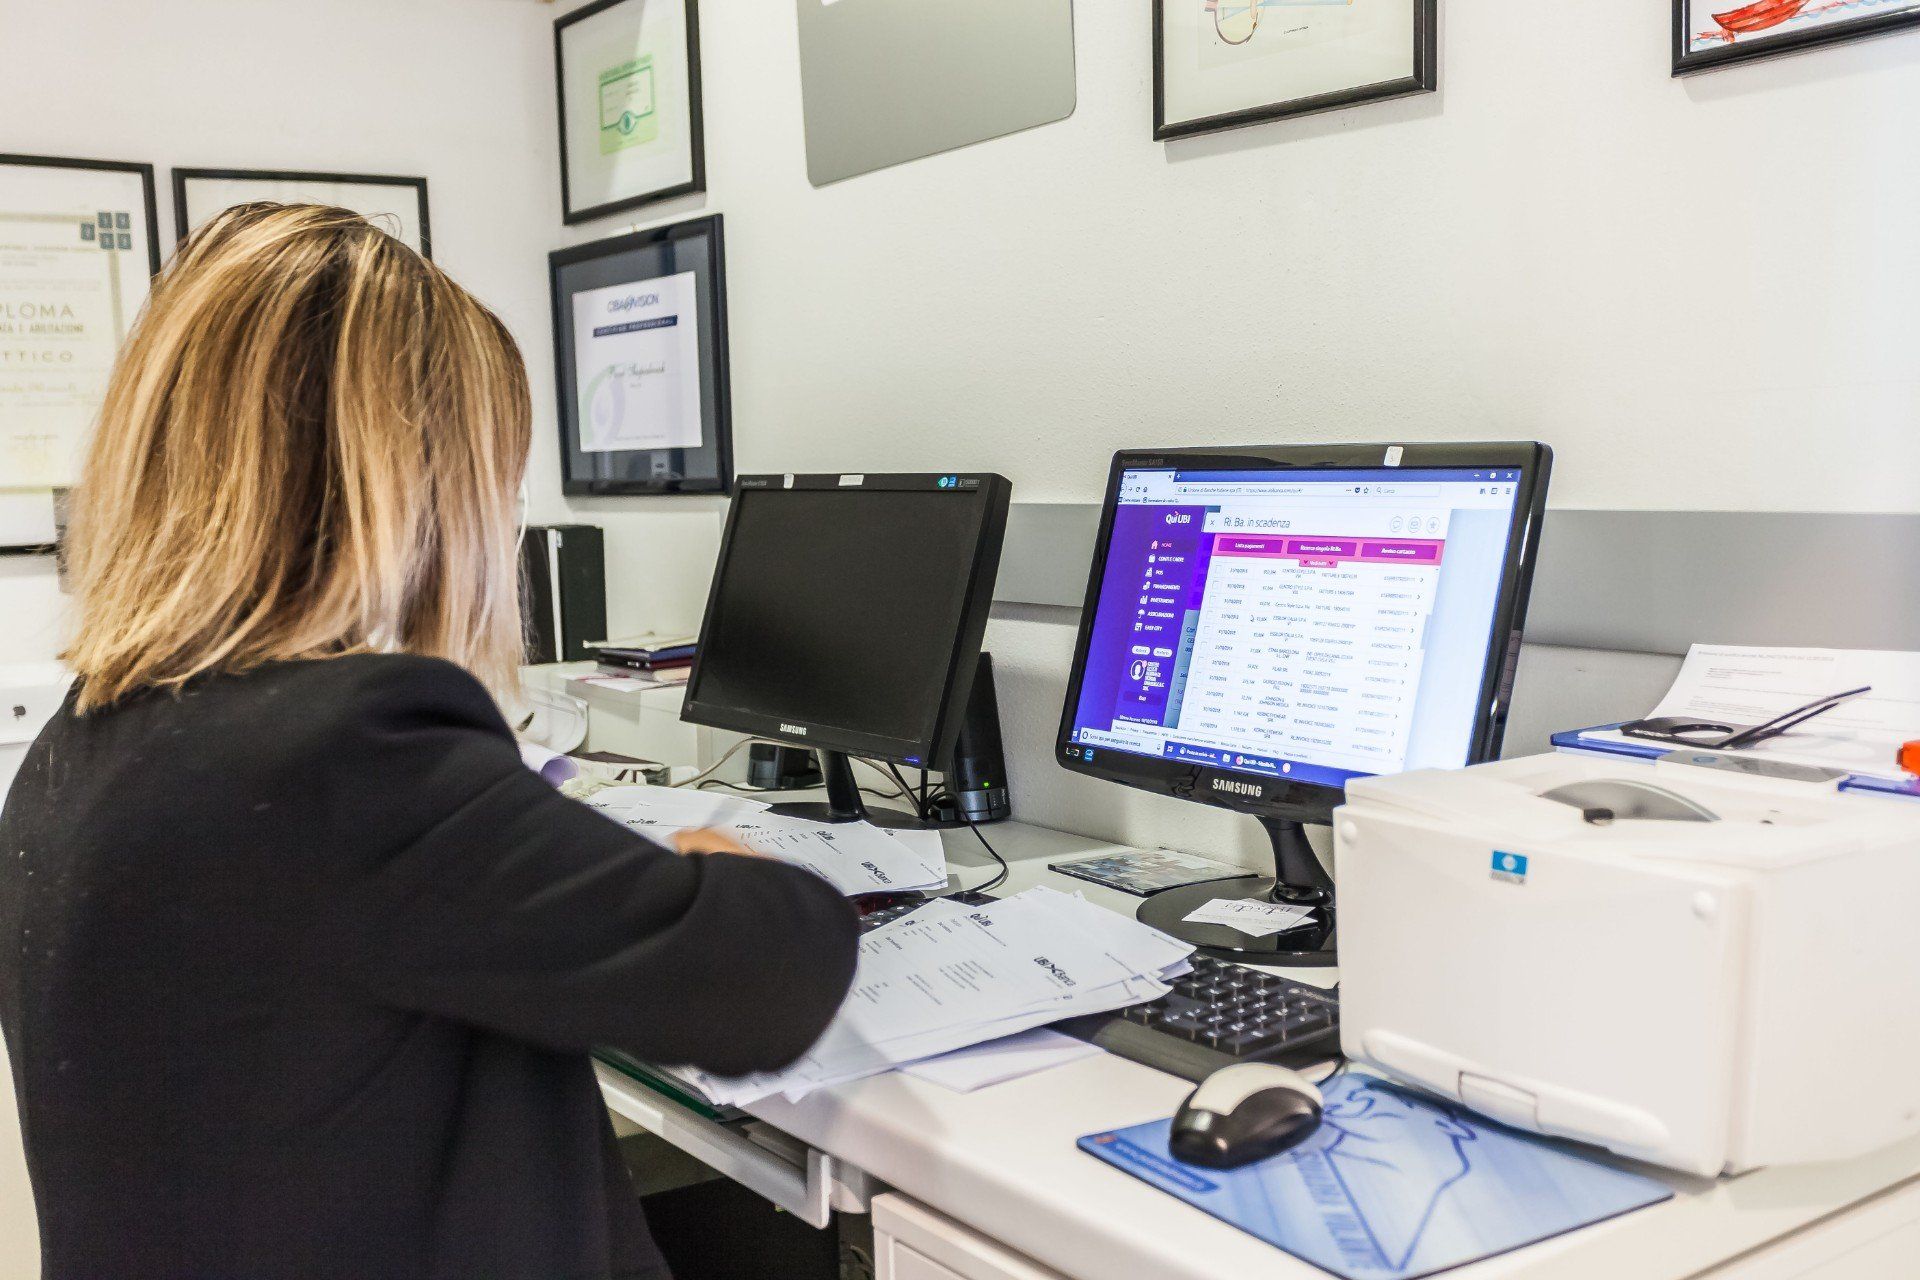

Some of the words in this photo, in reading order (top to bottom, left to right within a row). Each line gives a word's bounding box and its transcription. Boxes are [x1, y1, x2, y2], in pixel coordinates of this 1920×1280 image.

[1178, 514, 1191, 524] UBI
[1234, 517, 1245, 527] Ba.
[1255, 517, 1291, 528] scadenza
[779, 723, 807, 736] SAMSUNG
[1212, 778, 1262, 797] SAMSUNG
